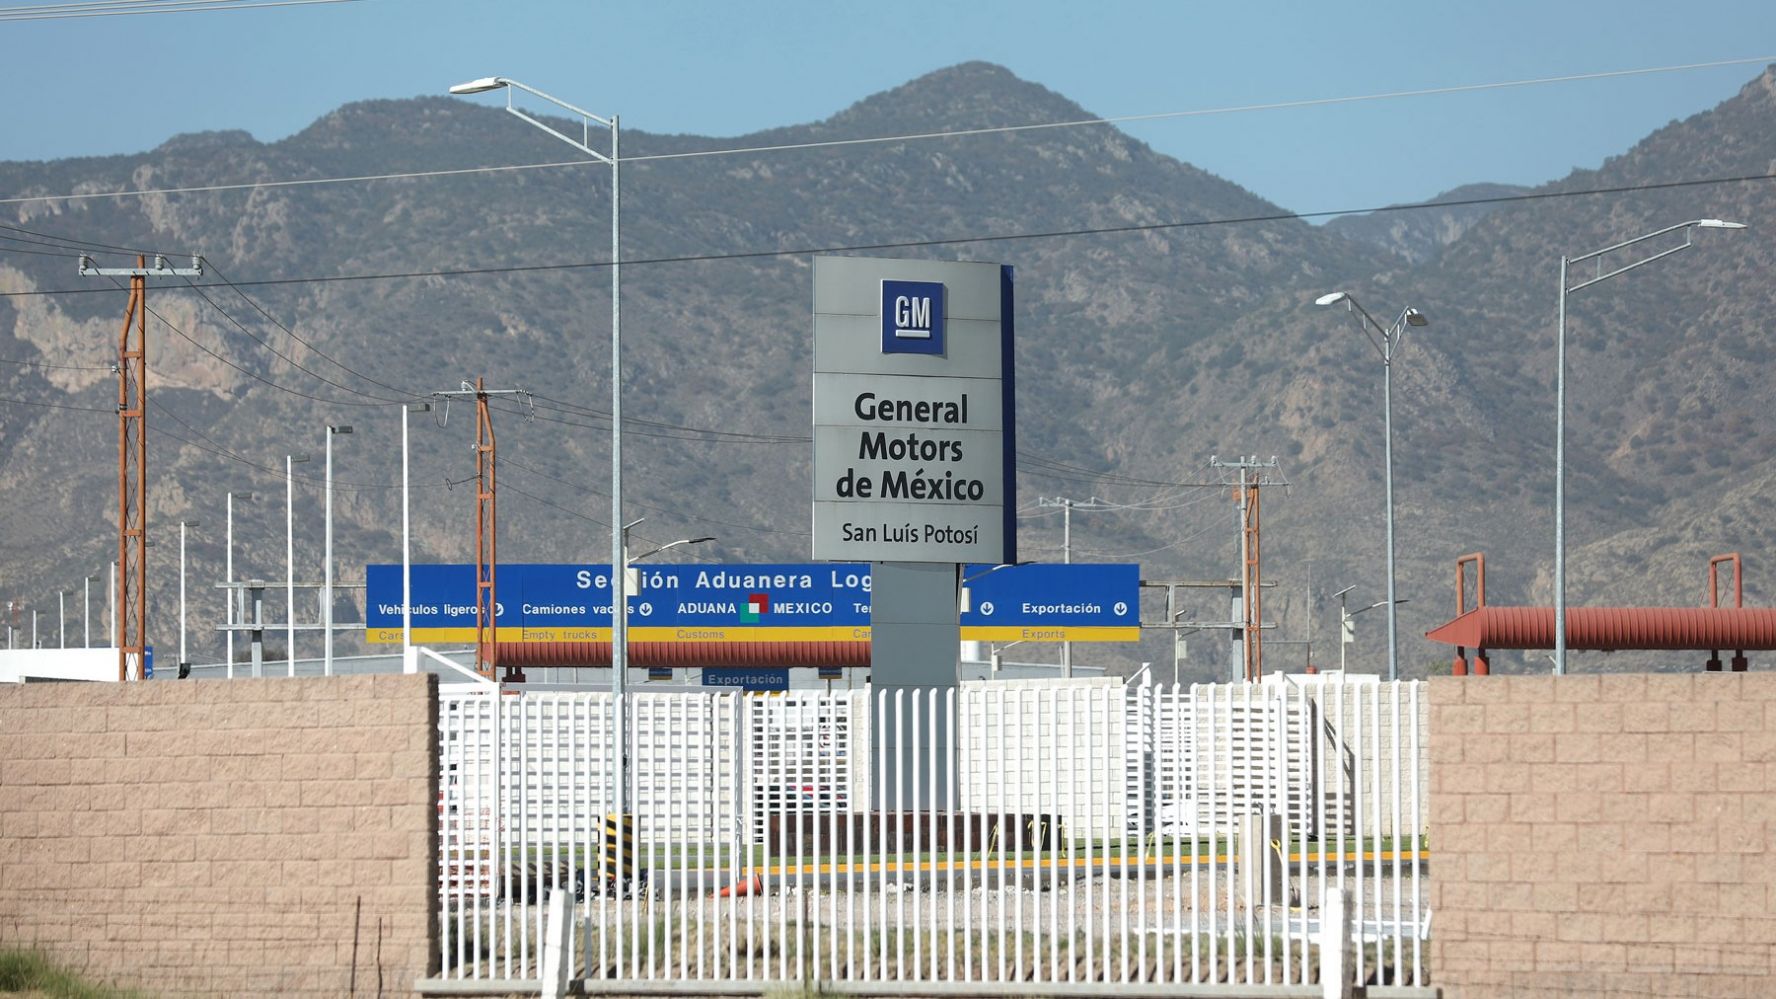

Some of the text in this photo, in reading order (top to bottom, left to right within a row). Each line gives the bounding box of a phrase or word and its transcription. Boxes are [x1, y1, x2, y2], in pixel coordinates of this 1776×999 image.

[895, 295, 931, 329] GM
[854, 392, 968, 424] General
[859, 431, 963, 462] Motors
[836, 468, 985, 501] de México
[842, 523, 979, 545] San Luís Potosí
[576, 570, 679, 589] Seión
[696, 570, 813, 589] Aduanera
[522, 603, 635, 615] Camiones vacs
[677, 602, 737, 614] ADUANA
[773, 602, 833, 614] MEXICO
[1021, 602, 1101, 615] Exportación
[522, 629, 598, 640] Empty trucks
[676, 629, 725, 640] Customs
[1022, 629, 1066, 640] Exports
[708, 674, 783, 686] Exportación
